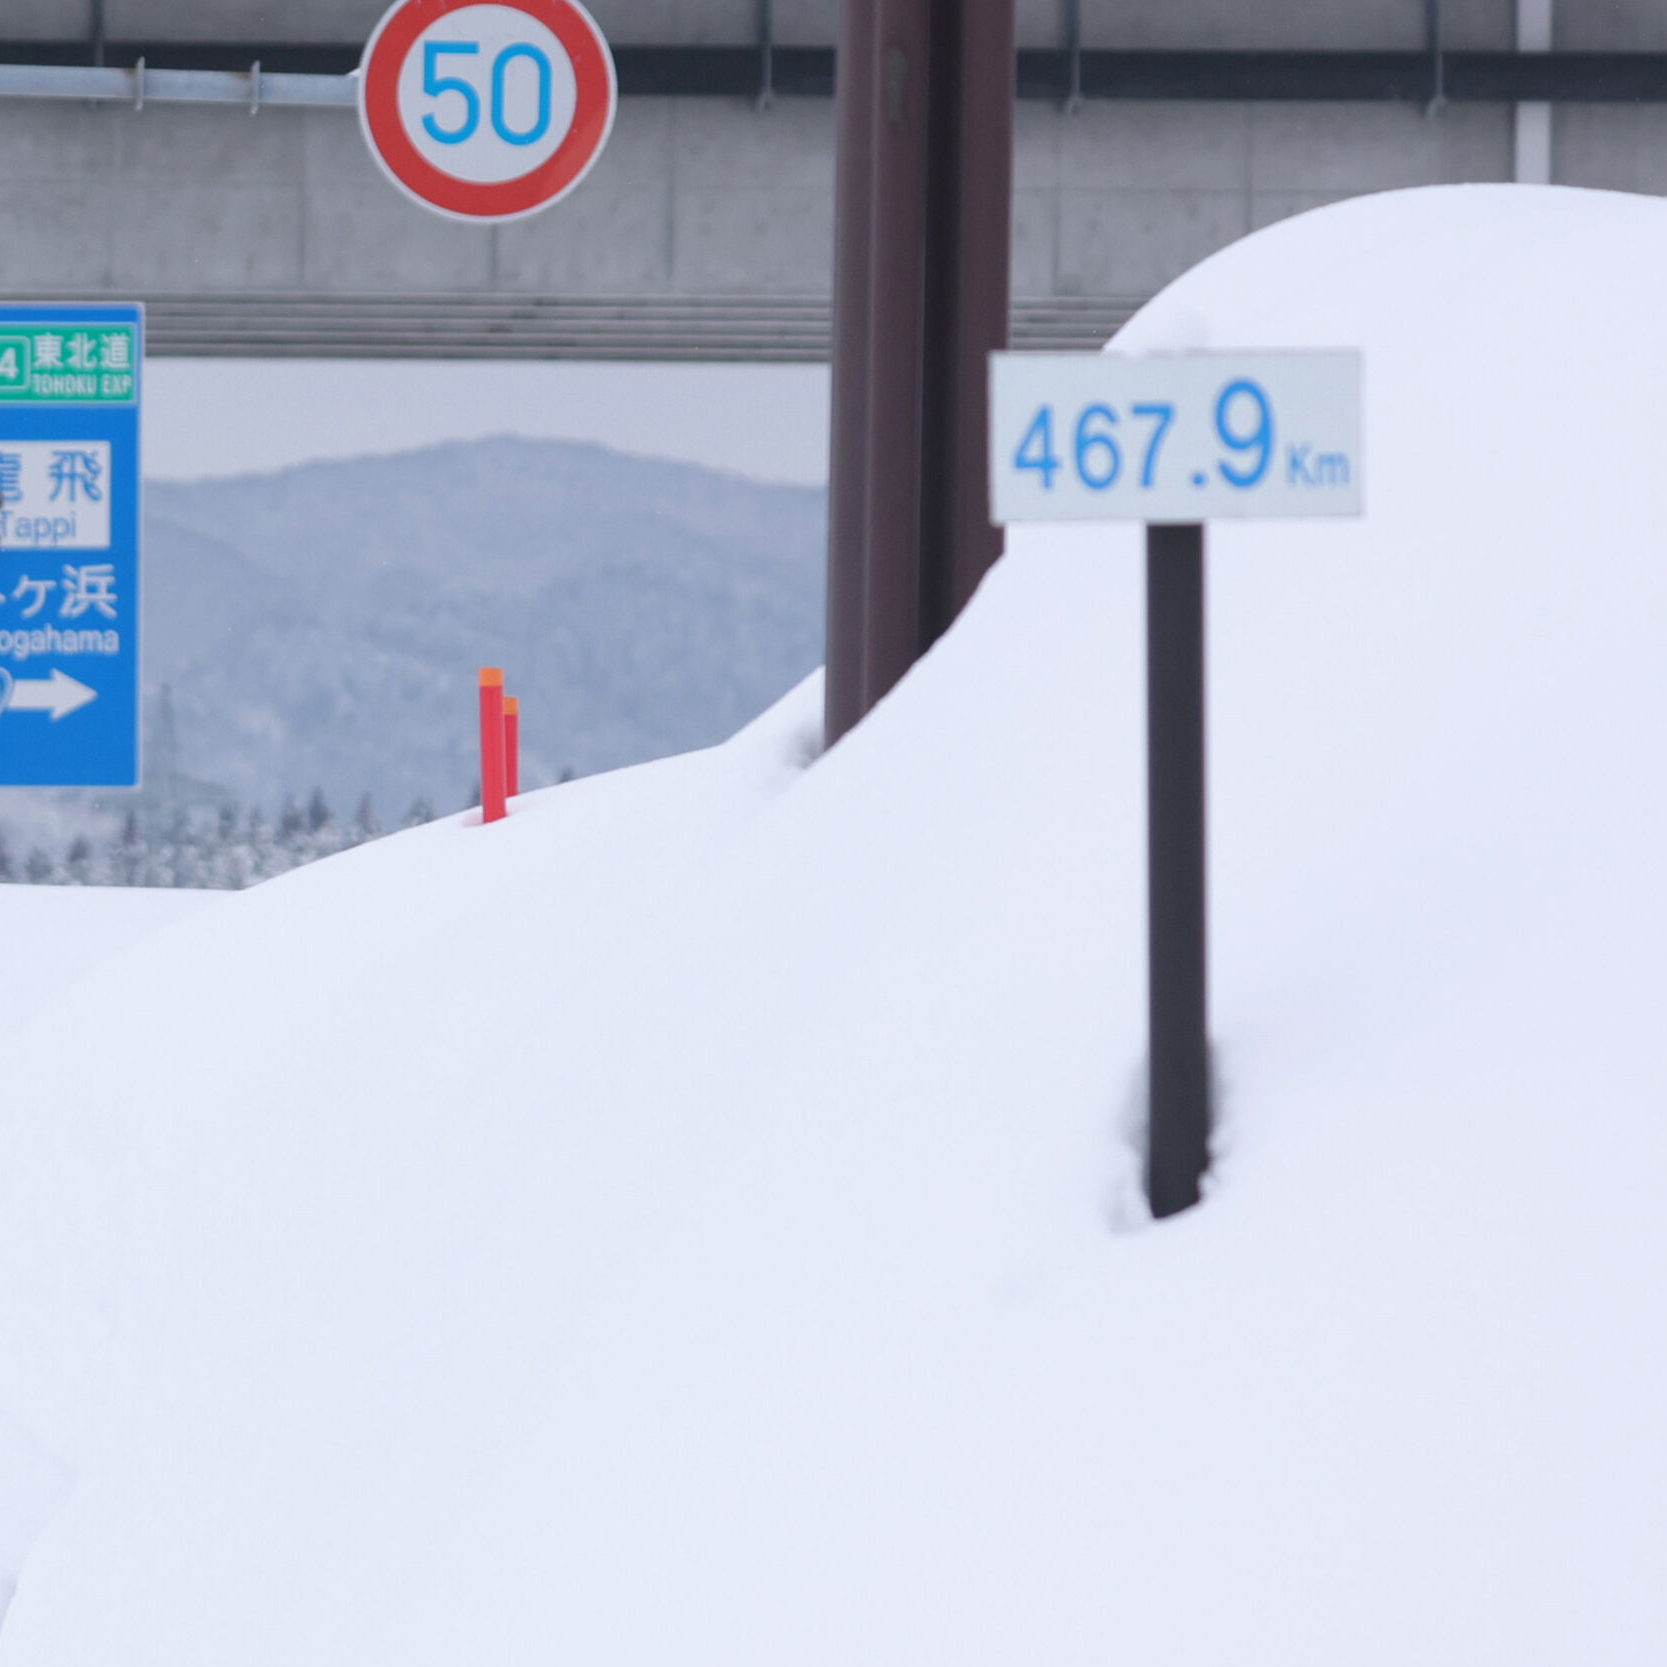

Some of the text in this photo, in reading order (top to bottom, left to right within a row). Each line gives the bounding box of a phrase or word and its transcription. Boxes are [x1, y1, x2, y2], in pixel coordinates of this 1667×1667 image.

[421, 41, 552, 146] 50
[33, 332, 131, 371] 東北道
[33, 374, 131, 395] TOHOKU EXP
[1012, 375, 1351, 492] 467.9 Km
[0, 509, 77, 544] Tappi
